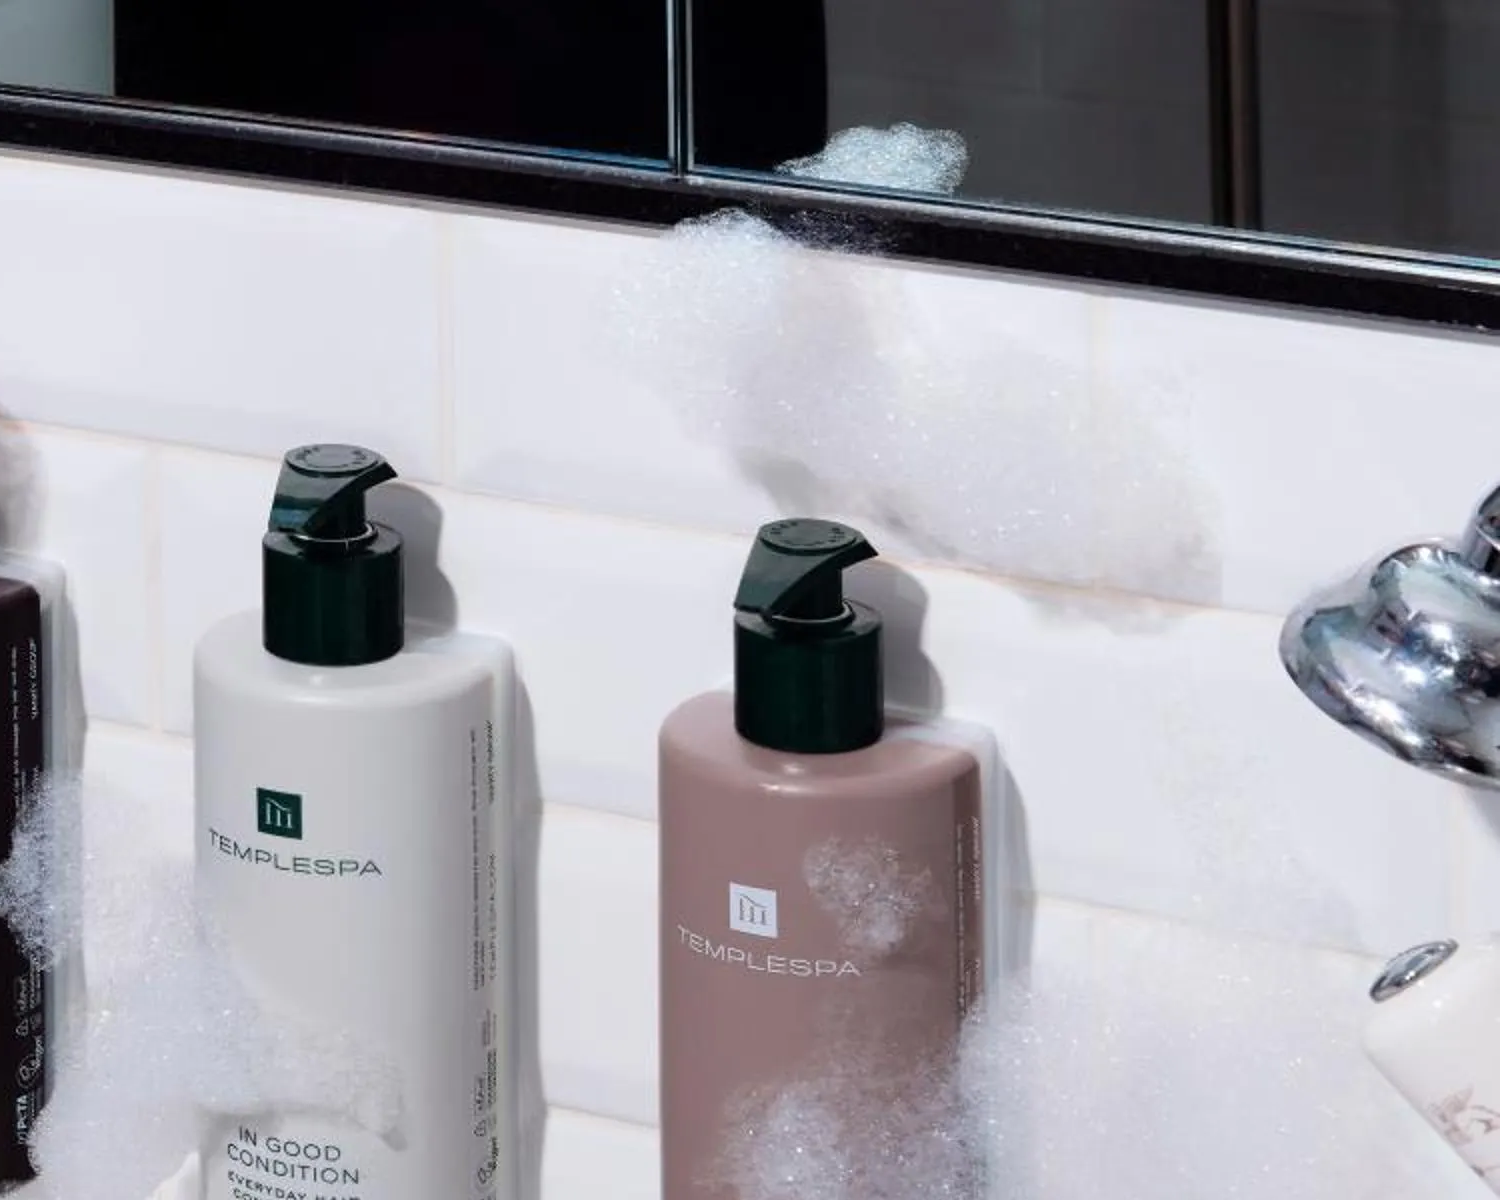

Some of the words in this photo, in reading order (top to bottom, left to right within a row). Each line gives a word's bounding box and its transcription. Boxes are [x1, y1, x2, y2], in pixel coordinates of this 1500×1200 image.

[208, 827, 382, 876] TEMPLESPA
[677, 923, 861, 977] TEMPLESPA
[227, 1143, 359, 1184] CONDITION
[239, 1125, 257, 1147] IN
[265, 1136, 341, 1161] GOOD
[228, 1170, 307, 1200] EVERYDAY
